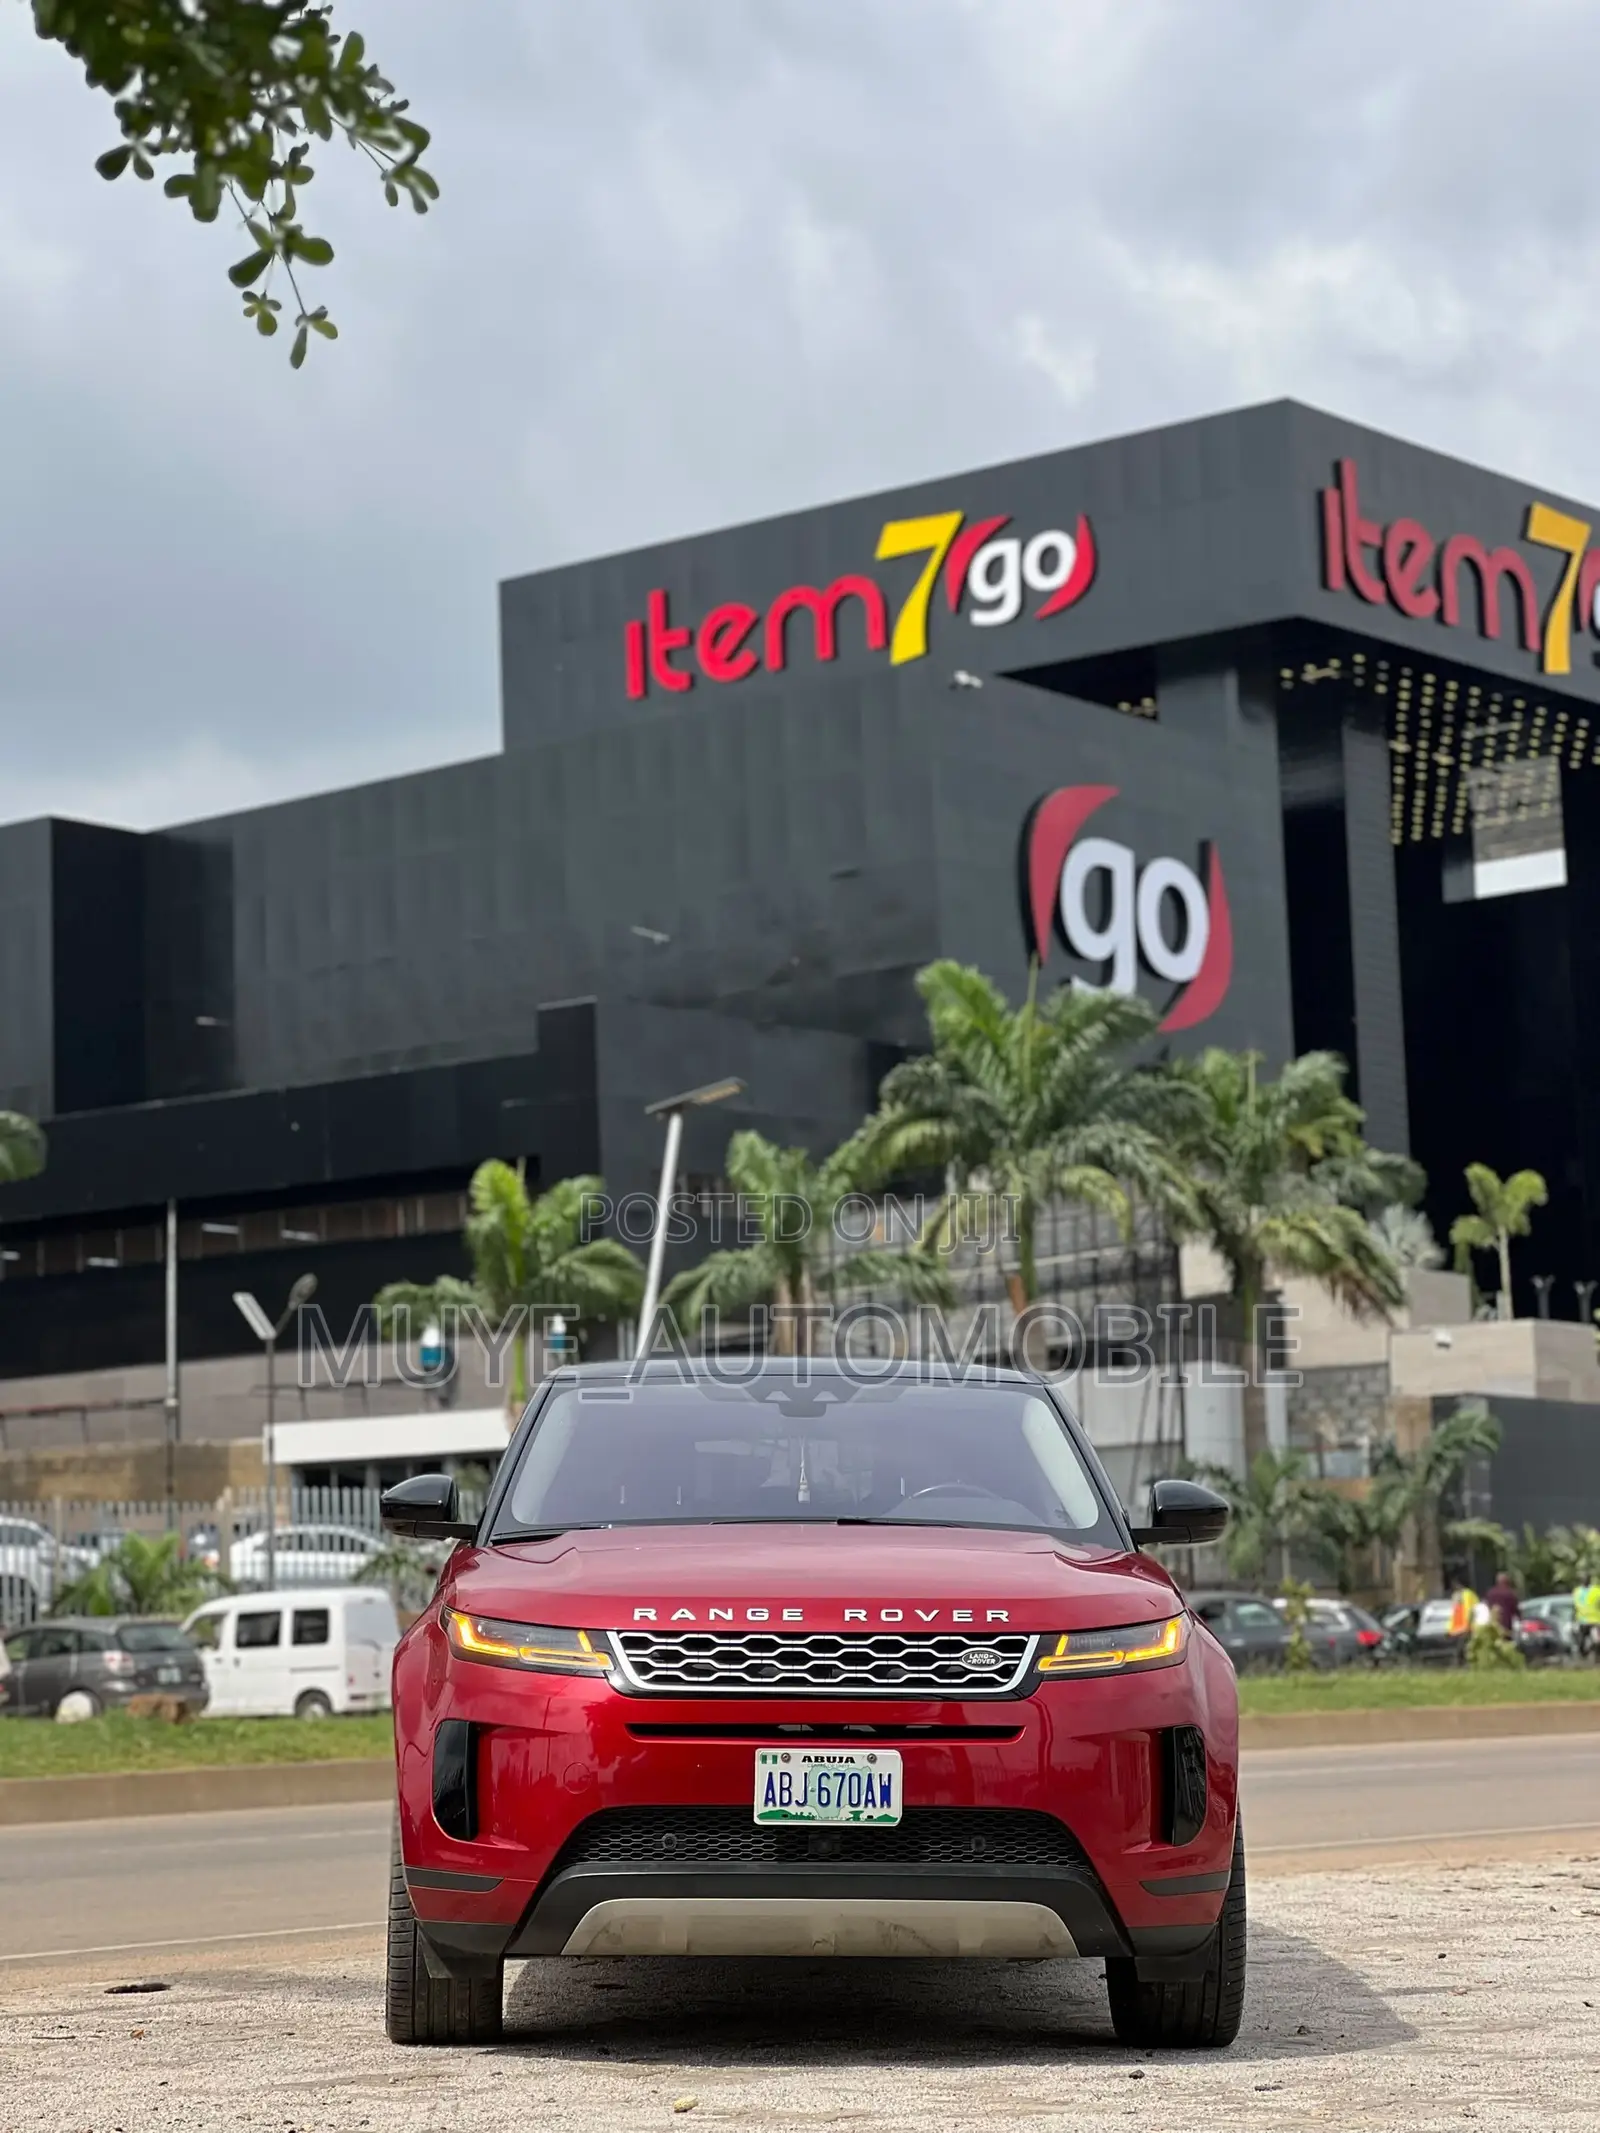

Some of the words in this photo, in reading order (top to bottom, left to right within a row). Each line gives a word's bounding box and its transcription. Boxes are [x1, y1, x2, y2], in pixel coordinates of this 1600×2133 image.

[633, 1607, 804, 1622] RANGE
[844, 1608, 1010, 1624] ROVER
[801, 1755, 856, 1764] ABUJA
